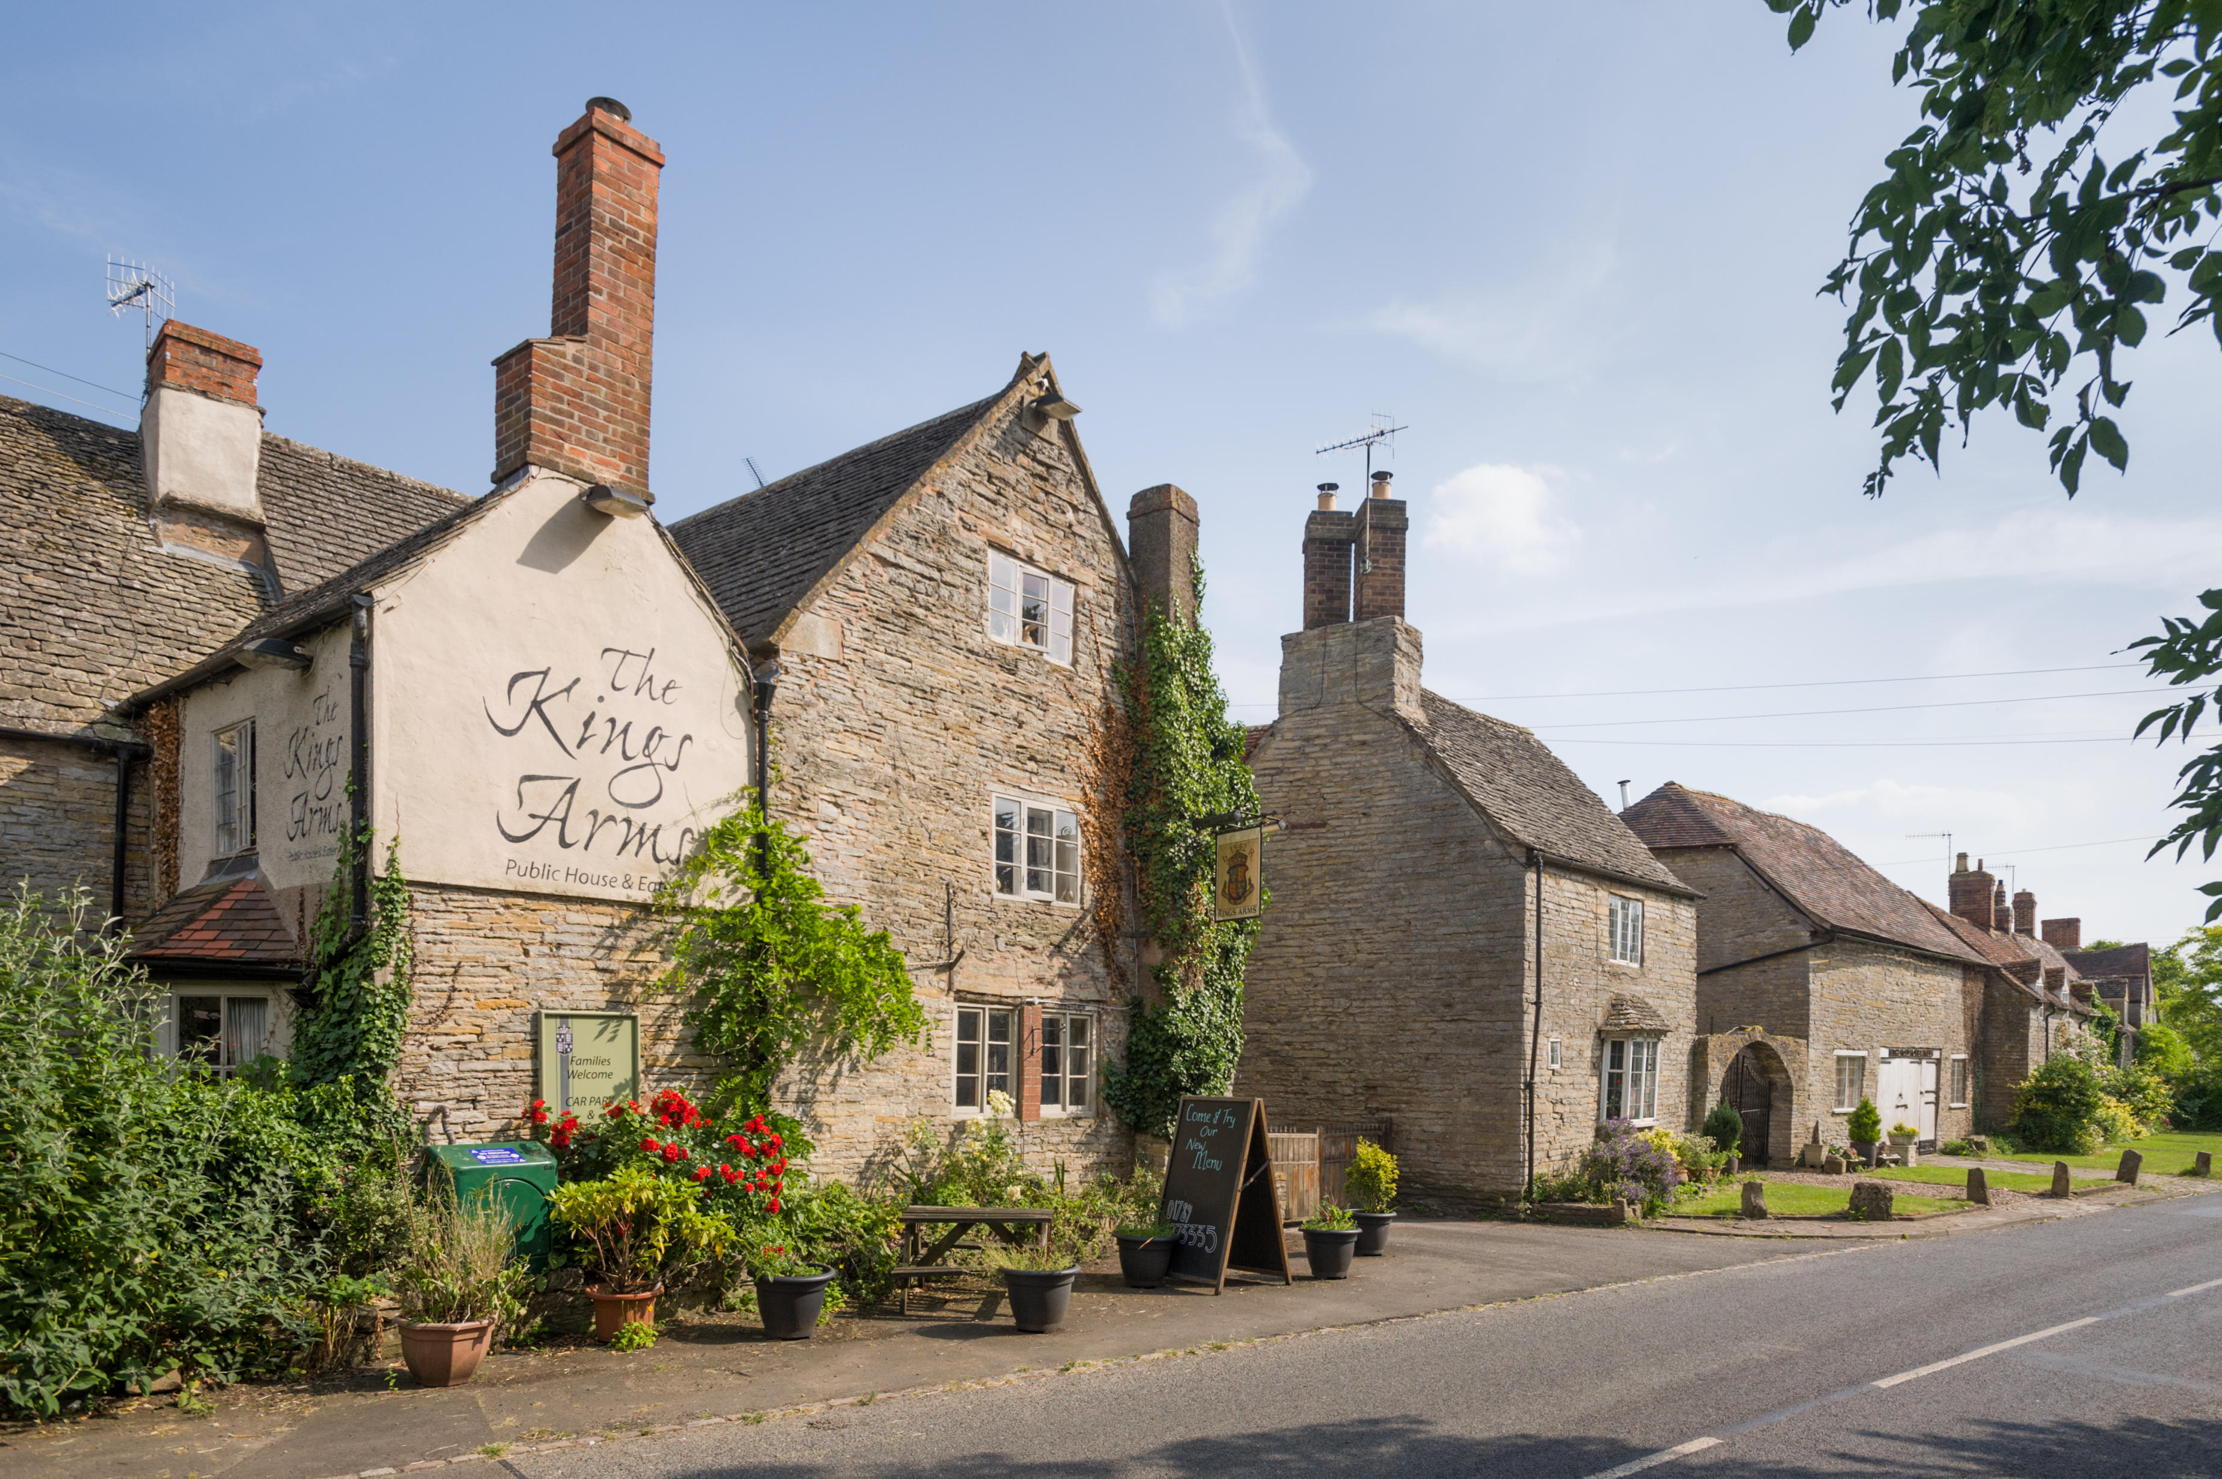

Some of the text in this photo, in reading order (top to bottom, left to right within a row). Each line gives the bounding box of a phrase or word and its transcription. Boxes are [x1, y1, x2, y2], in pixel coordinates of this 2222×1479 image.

[601, 647, 683, 705] The
[313, 685, 337, 726] The
[482, 666, 693, 809] Kings
[284, 727, 343, 801] Kings
[287, 791, 342, 842] Arms
[496, 774, 695, 866] Arms
[505, 859, 561, 882] Public
[565, 867, 618, 889] House
[622, 873, 634, 889] &
[1239, 905, 1257, 914] ARMS
[570, 1055, 611, 1066] Families
[567, 1069, 614, 1080] Welcome
[565, 1096, 587, 1107] CAR
[587, 1110, 595, 1120] &
[1186, 1103, 1211, 1123] Come
[1222, 1108, 1236, 1129] Try
[1200, 1125, 1218, 1137] Our
[1185, 1137, 1207, 1151] New
[1192, 1150, 1223, 1171] Menu
